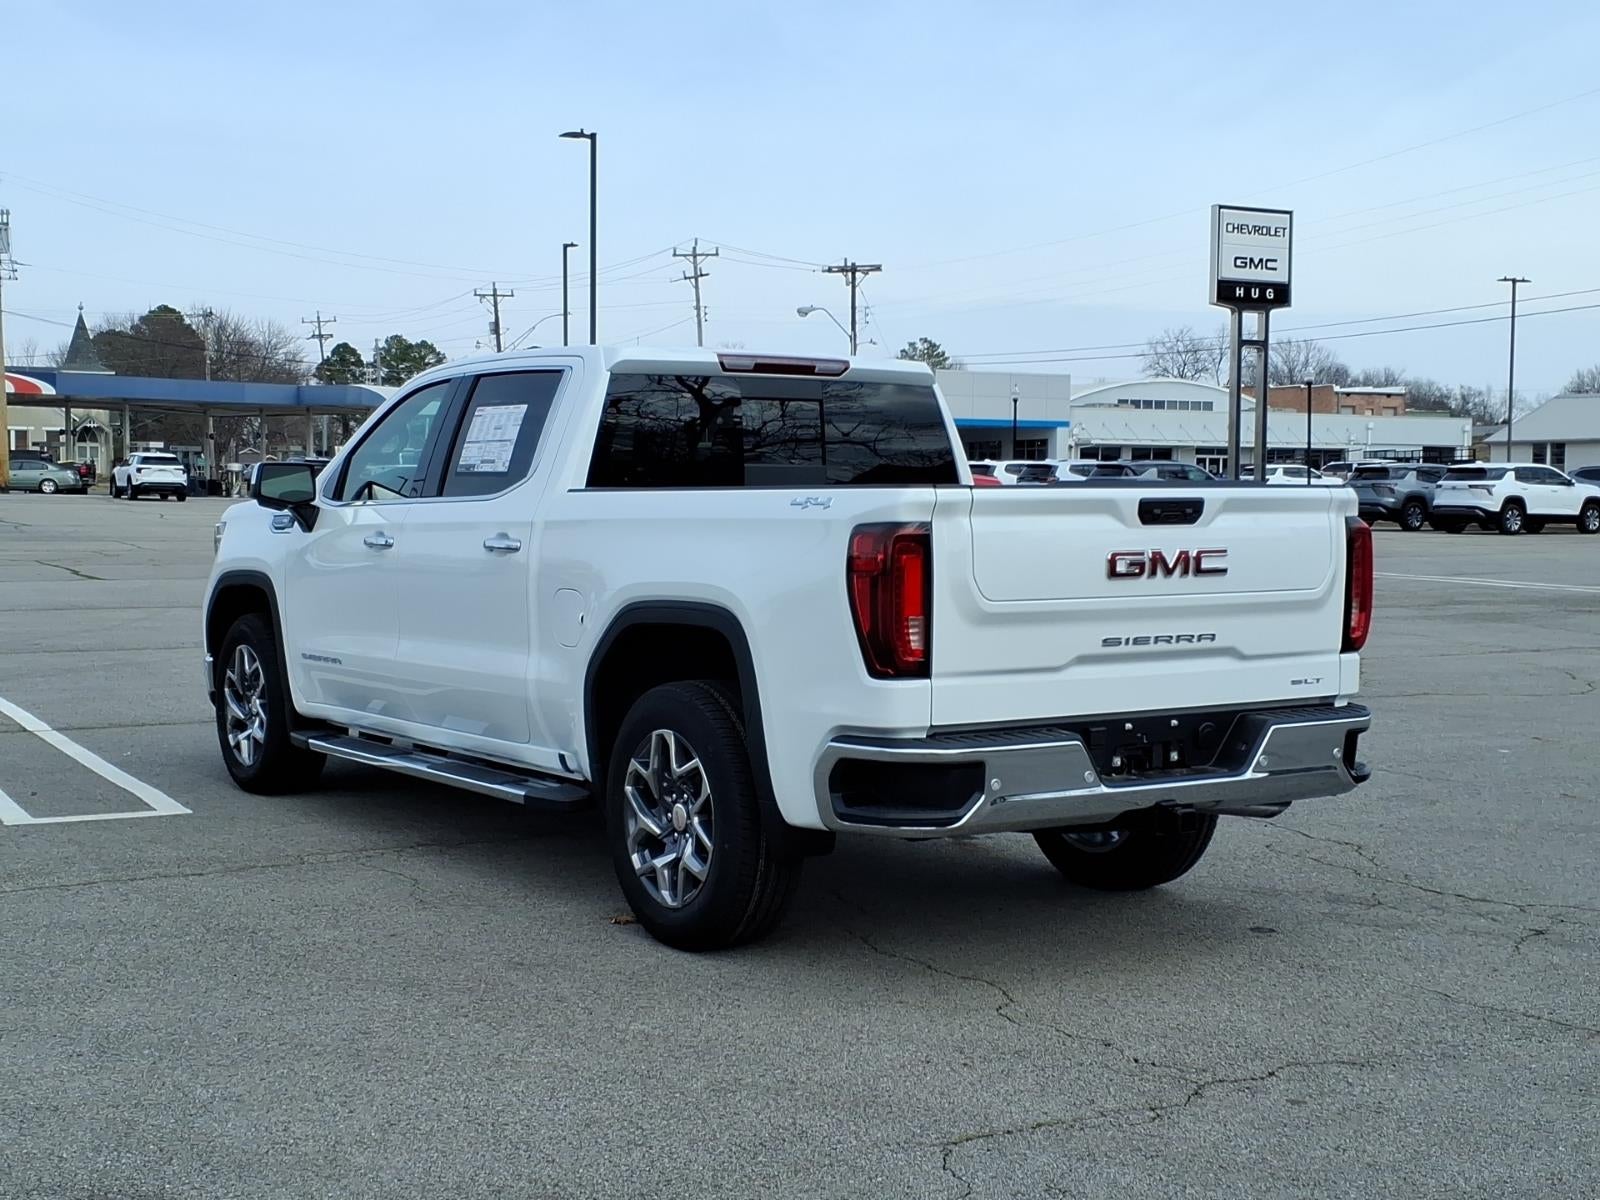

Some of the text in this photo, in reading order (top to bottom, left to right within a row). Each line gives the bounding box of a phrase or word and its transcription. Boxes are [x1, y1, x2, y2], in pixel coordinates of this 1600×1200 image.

[1225, 222, 1287, 238] CHEVROLET
[1233, 256, 1278, 271] GMC
[1106, 548, 1228, 580] GMC
[1101, 633, 1216, 647] SIERRA
